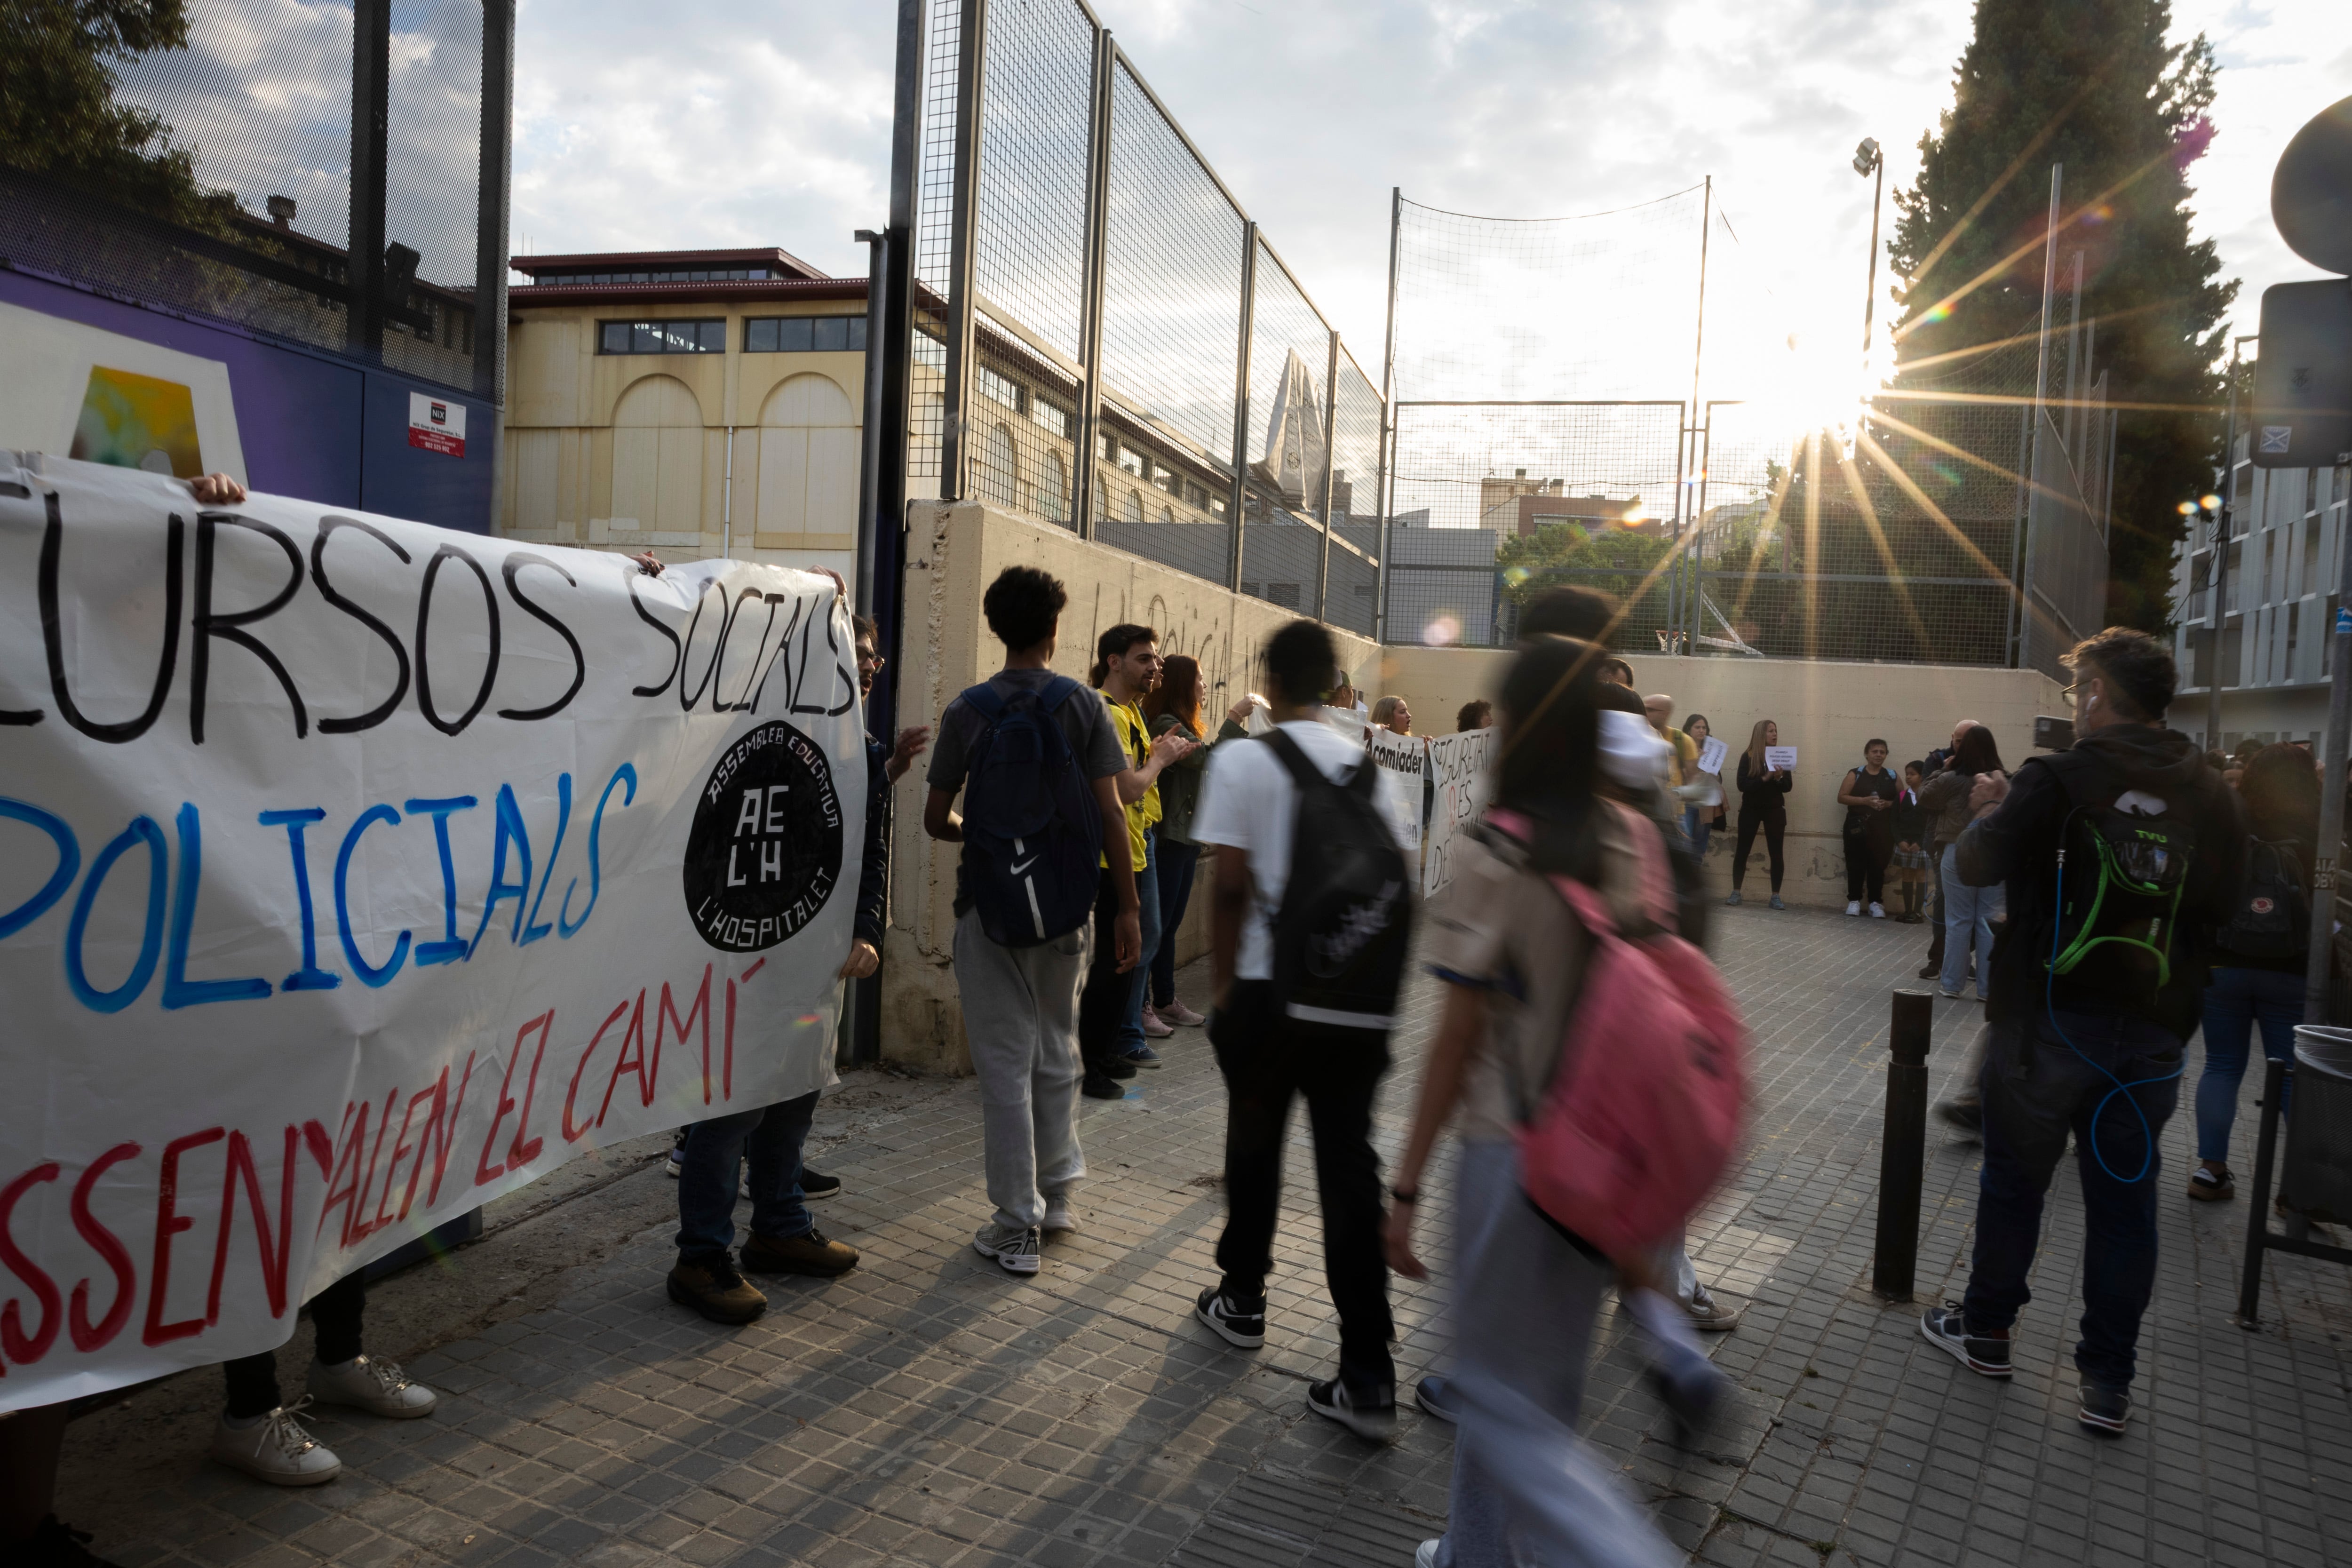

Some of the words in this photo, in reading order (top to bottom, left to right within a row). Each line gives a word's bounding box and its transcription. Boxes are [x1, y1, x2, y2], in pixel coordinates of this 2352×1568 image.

[0, 481, 585, 745] URSOS
[623, 565, 855, 717] SOCIALS
[707, 727, 784, 804] ASSEMBLEA
[734, 785, 789, 837] AE
[2135, 829, 2168, 843] TVU
[727, 841, 781, 887] L'H
[697, 867, 832, 947] L'HOSPITALET
[475, 1008, 555, 1186] EL
[562, 955, 766, 1144] CAMÍ
